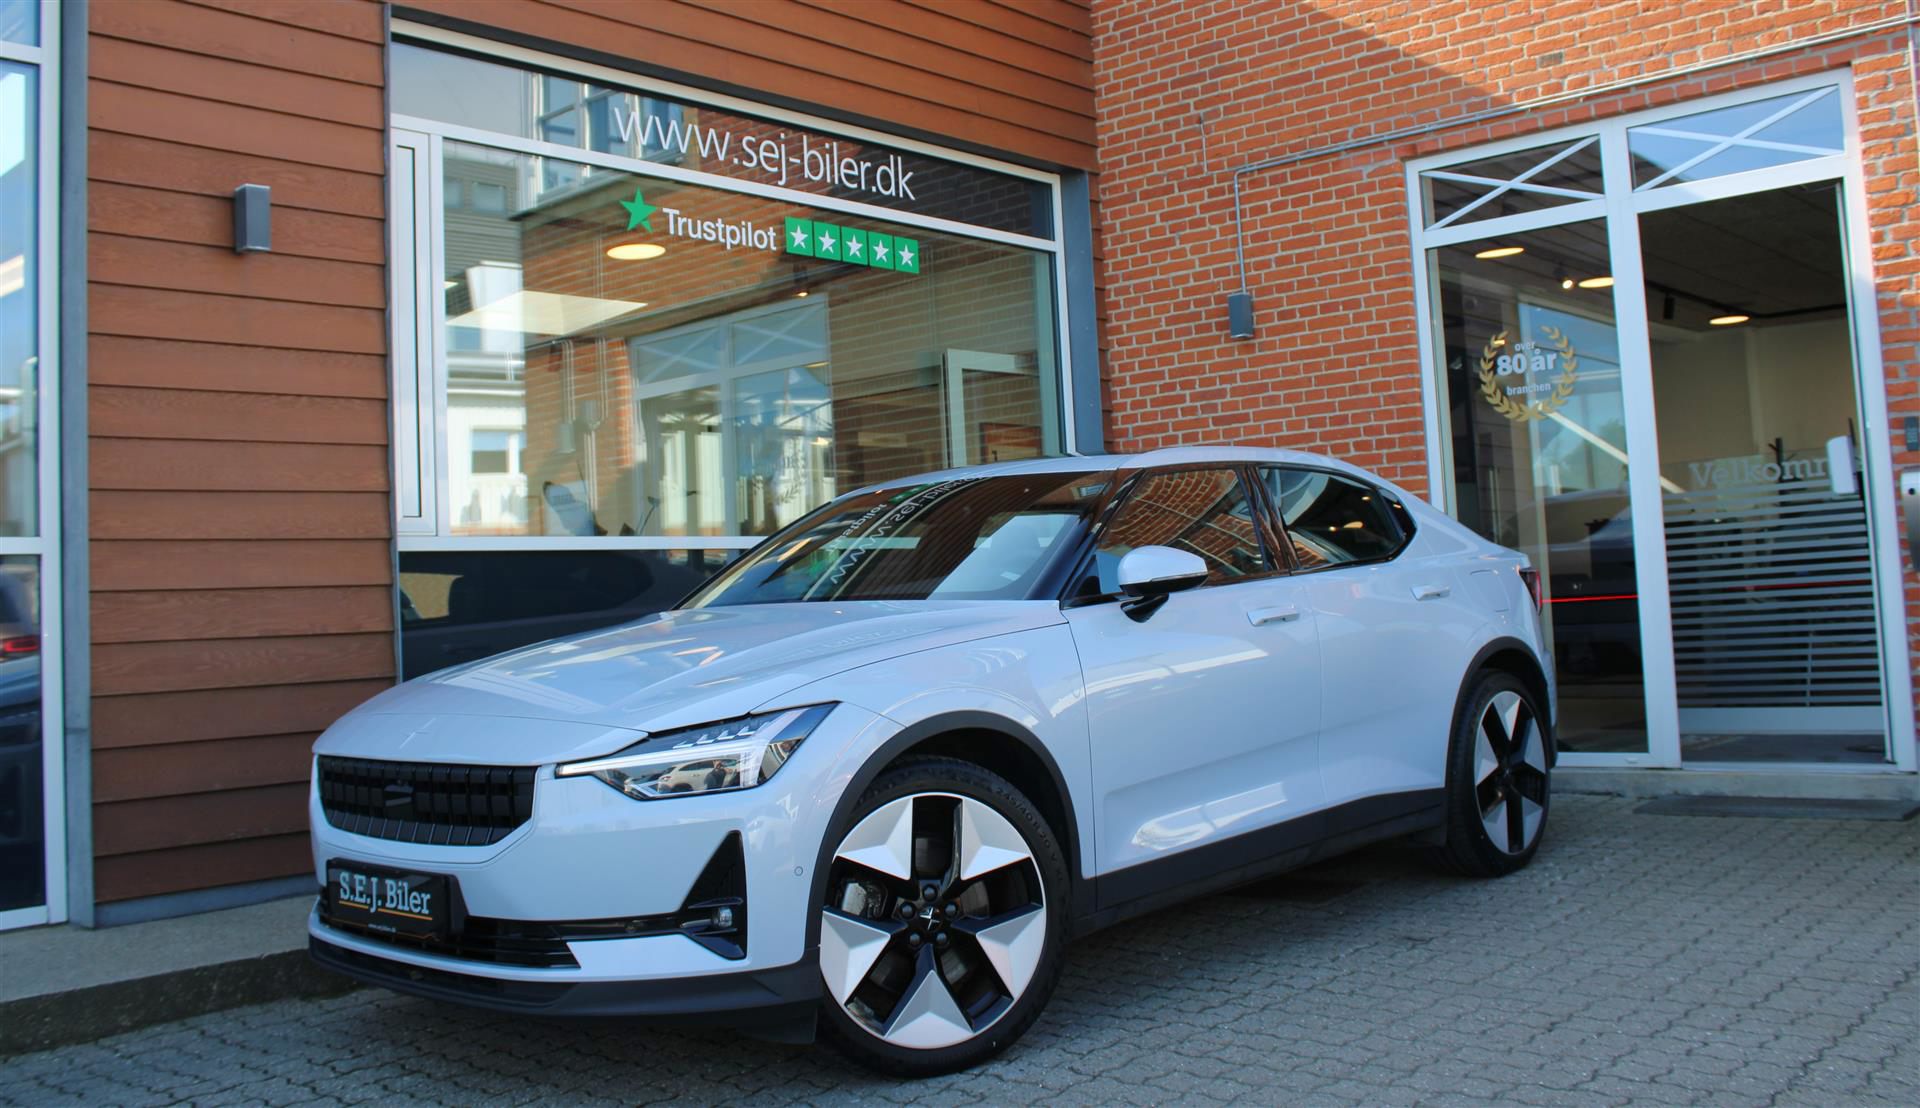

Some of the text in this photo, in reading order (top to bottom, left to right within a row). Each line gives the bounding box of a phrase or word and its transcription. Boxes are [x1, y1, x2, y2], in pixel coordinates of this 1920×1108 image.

[614, 107, 916, 201] www.sej-biler.dk
[662, 207, 777, 251] Trustpilot
[1496, 348, 1558, 376] 80 år
[1514, 341, 1536, 352] over
[1506, 382, 1552, 396] branchen
[339, 871, 431, 915] S.E.J. Biler
